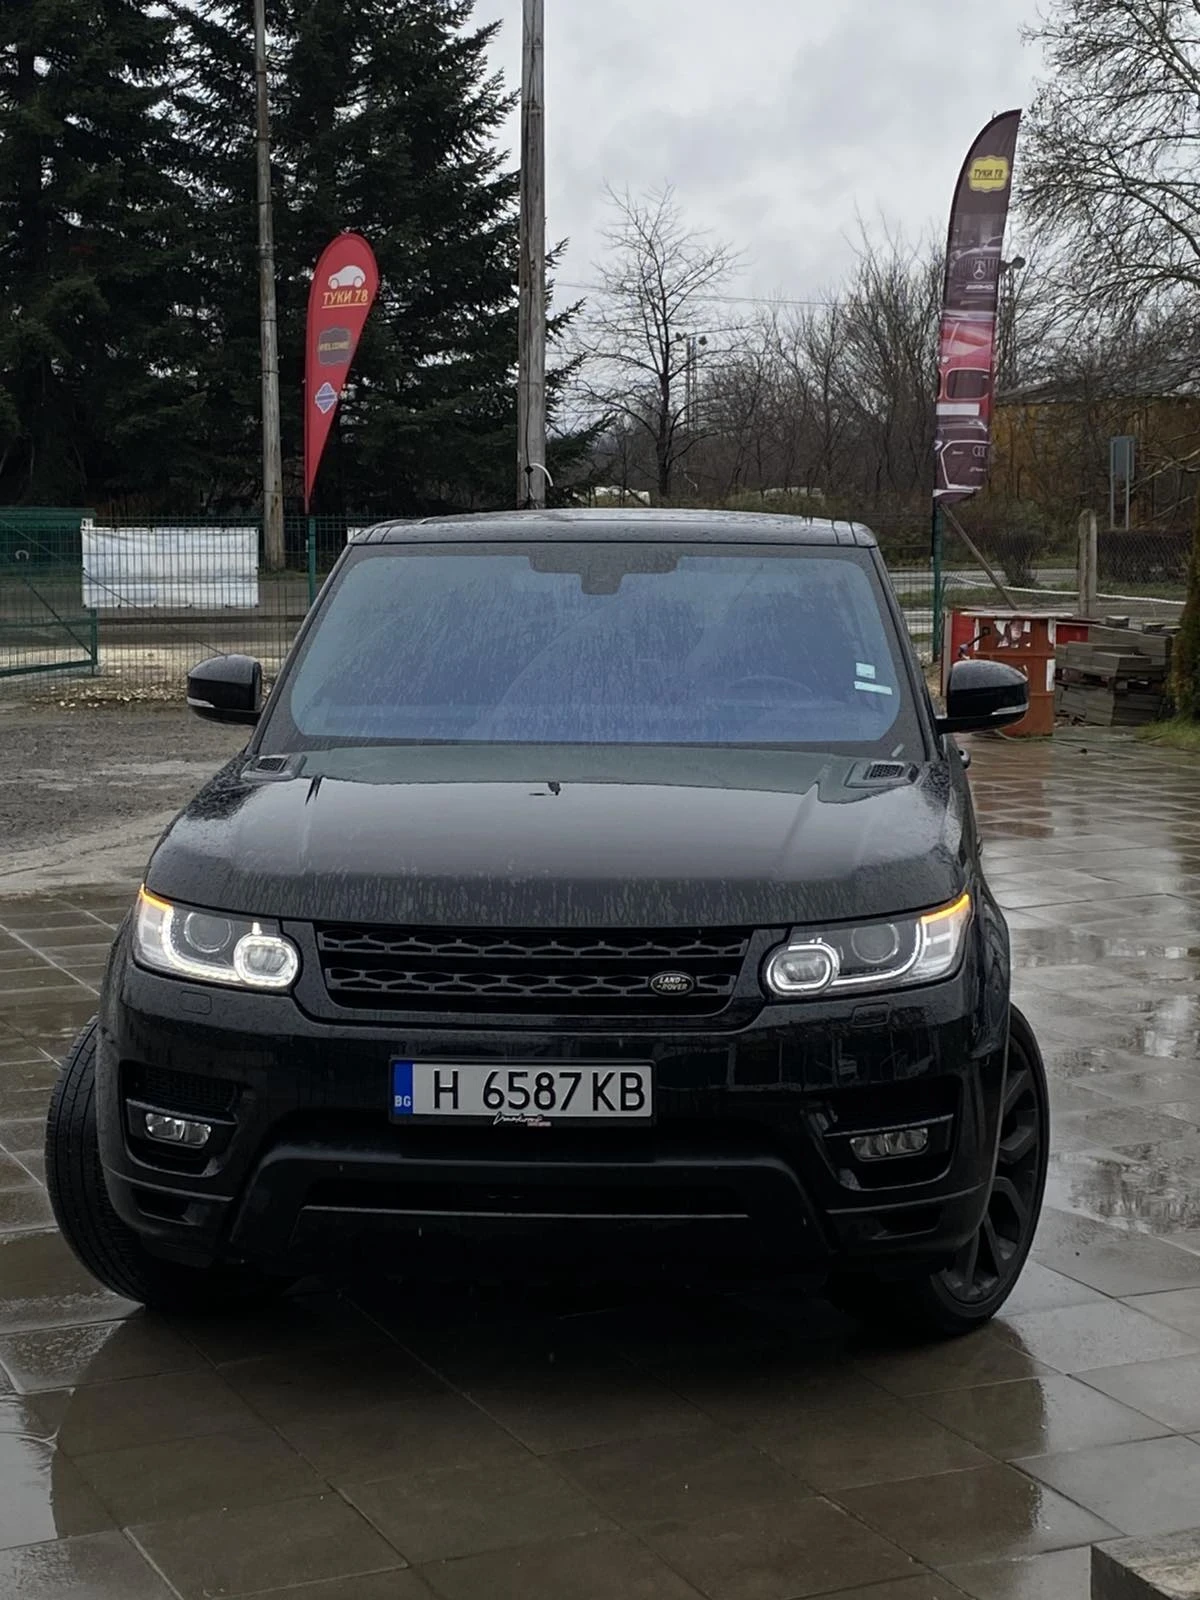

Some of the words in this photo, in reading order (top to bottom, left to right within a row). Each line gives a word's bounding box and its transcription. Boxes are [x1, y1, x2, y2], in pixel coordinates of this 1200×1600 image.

[322, 290, 353, 305] ТУКИ
[354, 288, 369, 304] 78
[433, 1069, 460, 1110] H
[482, 1070, 583, 1111] 6587
[592, 1071, 646, 1112] KB
[393, 1095, 412, 1107] BG
